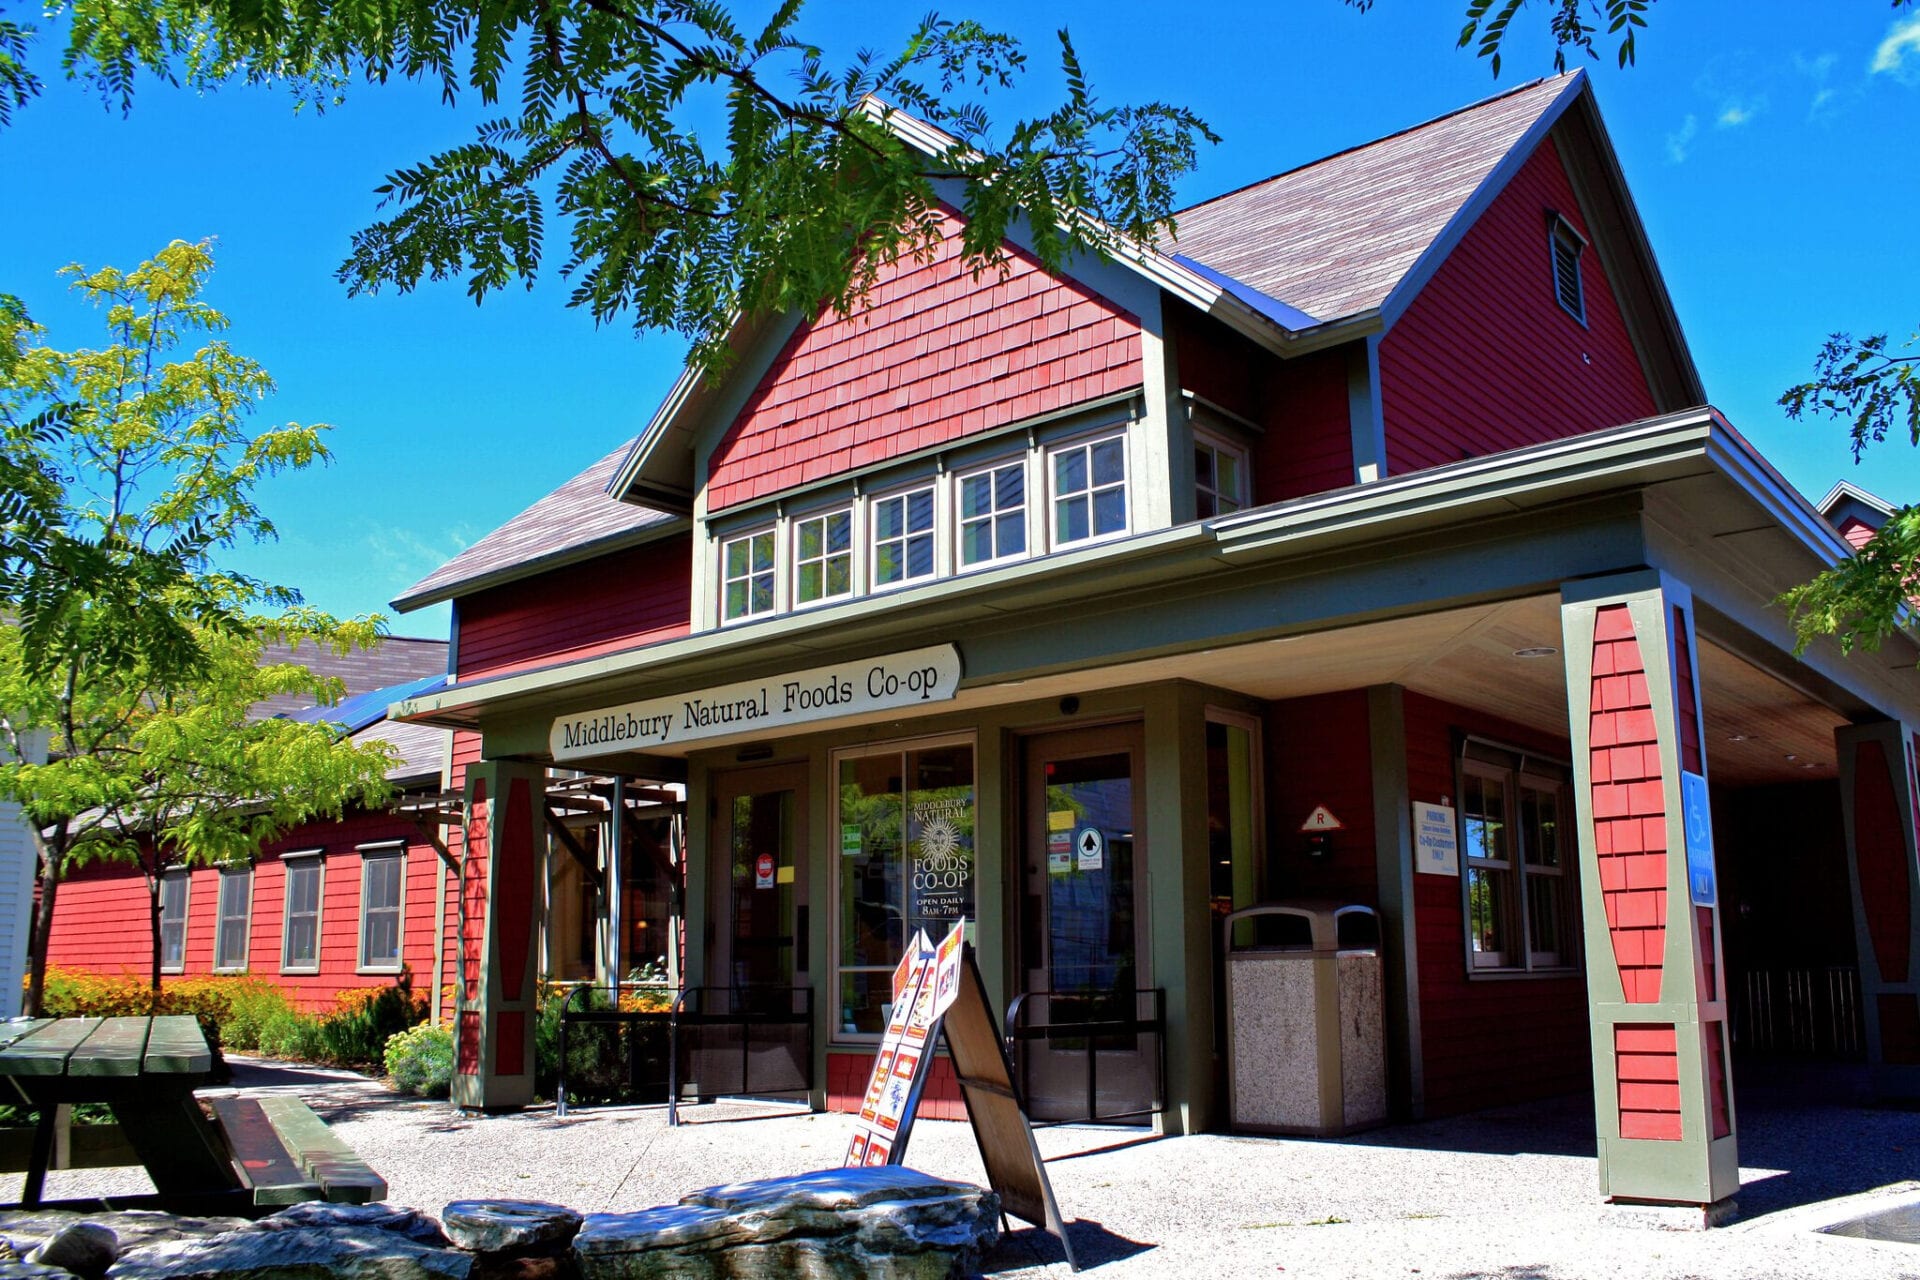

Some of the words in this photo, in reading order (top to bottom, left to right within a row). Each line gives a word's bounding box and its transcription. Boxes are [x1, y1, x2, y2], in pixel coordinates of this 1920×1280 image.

[564, 711, 673, 749] Middlebury
[684, 689, 769, 729] Natural
[783, 675, 853, 713] Foods
[867, 666, 938, 700] Co-op
[914, 798, 967, 811] MIDDLEBURY
[914, 807, 966, 822] NATURAL
[1317, 813, 1325, 824] R
[914, 855, 968, 872] FOODS
[913, 871, 968, 890] CO-OP
[916, 898, 938, 906] OPEN
[940, 897, 964, 905] DAILY
